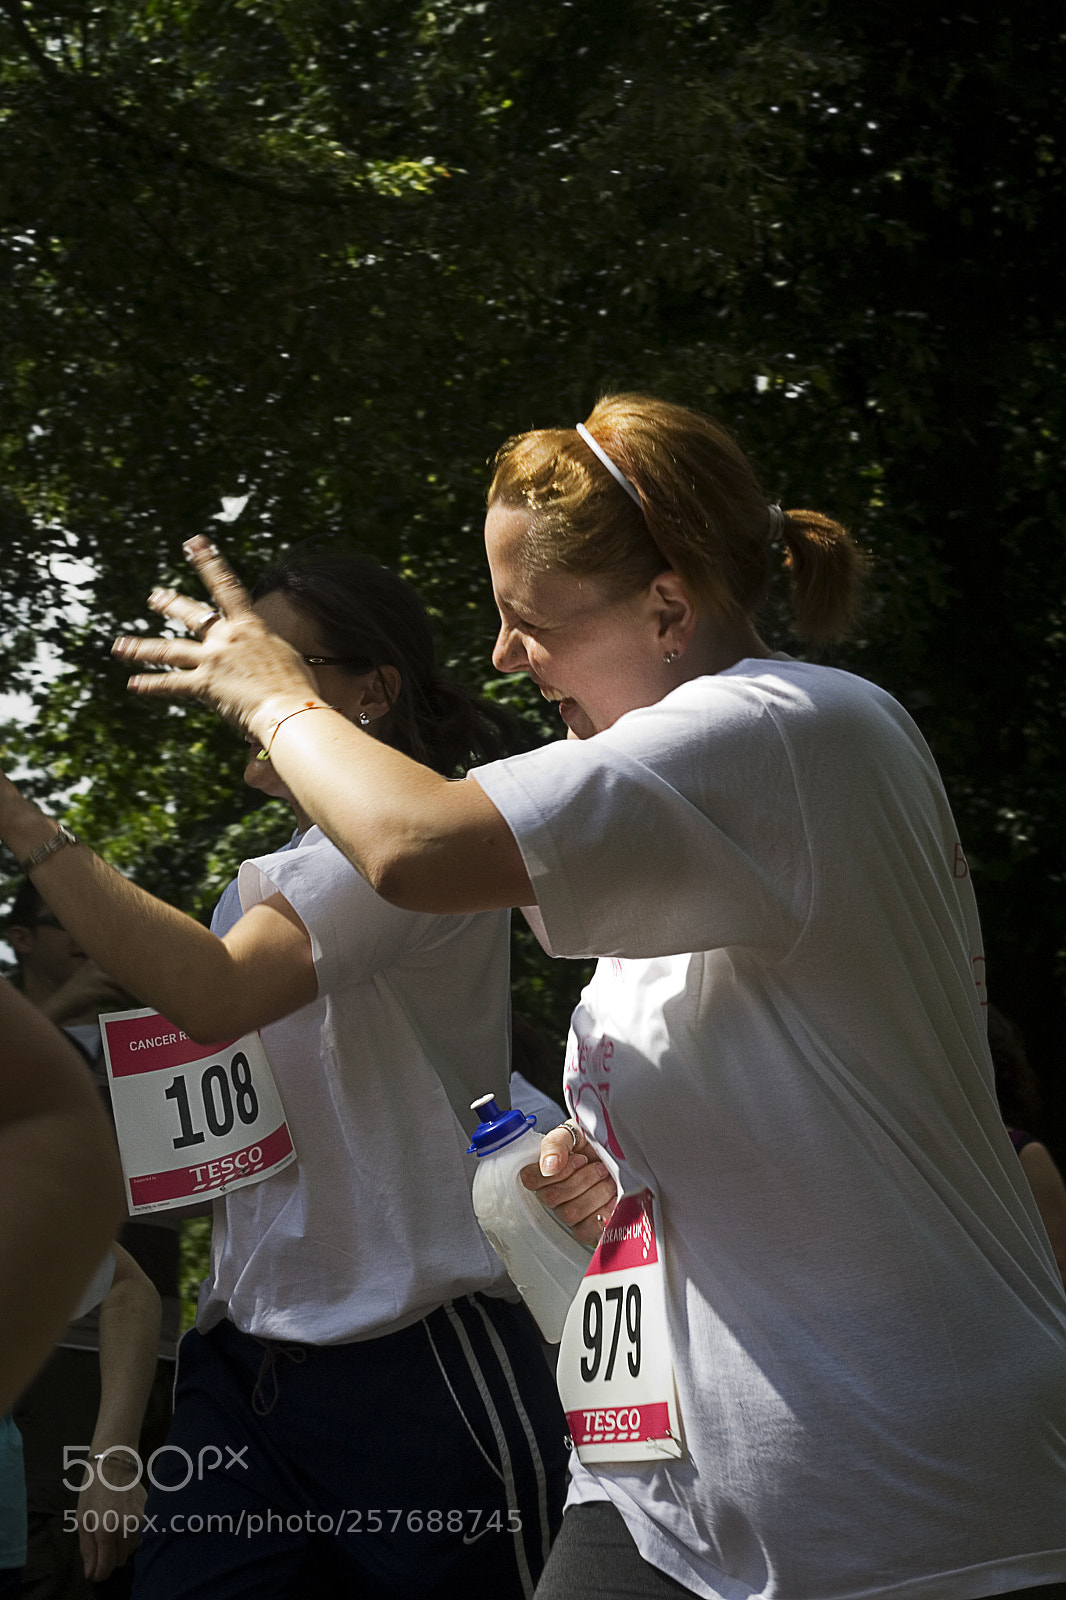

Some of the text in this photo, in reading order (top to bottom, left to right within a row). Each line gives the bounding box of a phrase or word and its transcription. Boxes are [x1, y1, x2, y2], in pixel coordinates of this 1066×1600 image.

[129, 1032, 177, 1051] CANCER
[164, 1051, 259, 1150] 108
[189, 1146, 263, 1183] TESCO
[632, 1221, 643, 1239] UK
[580, 1283, 642, 1383] 979
[582, 1407, 641, 1433] TESCO
